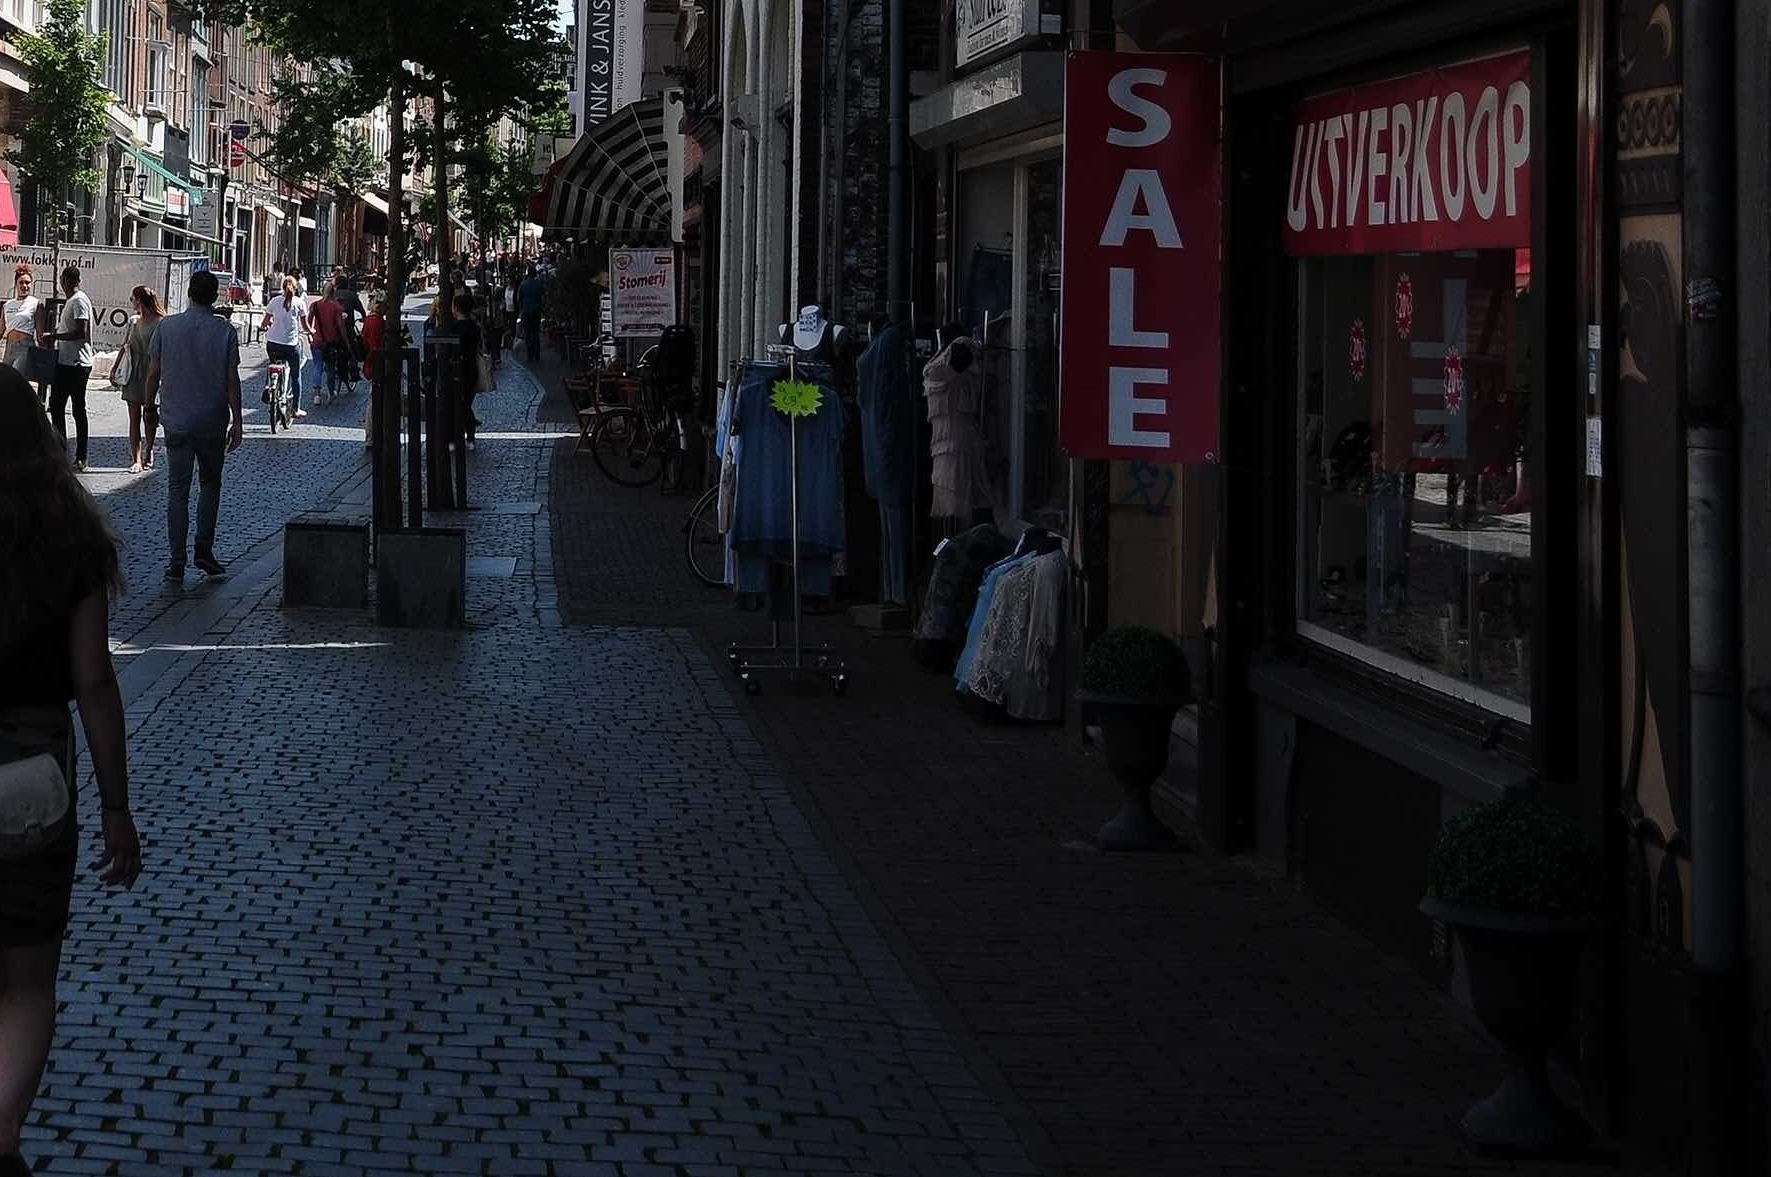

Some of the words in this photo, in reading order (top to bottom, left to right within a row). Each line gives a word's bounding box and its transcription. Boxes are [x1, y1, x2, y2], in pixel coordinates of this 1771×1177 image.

[1286, 80, 1531, 232] UITVERKOOP
[2, 252, 96, 269] www.fokkrvof.nl
[618, 269, 668, 290] Stomerij
[1099, 67, 1183, 449] SALE
